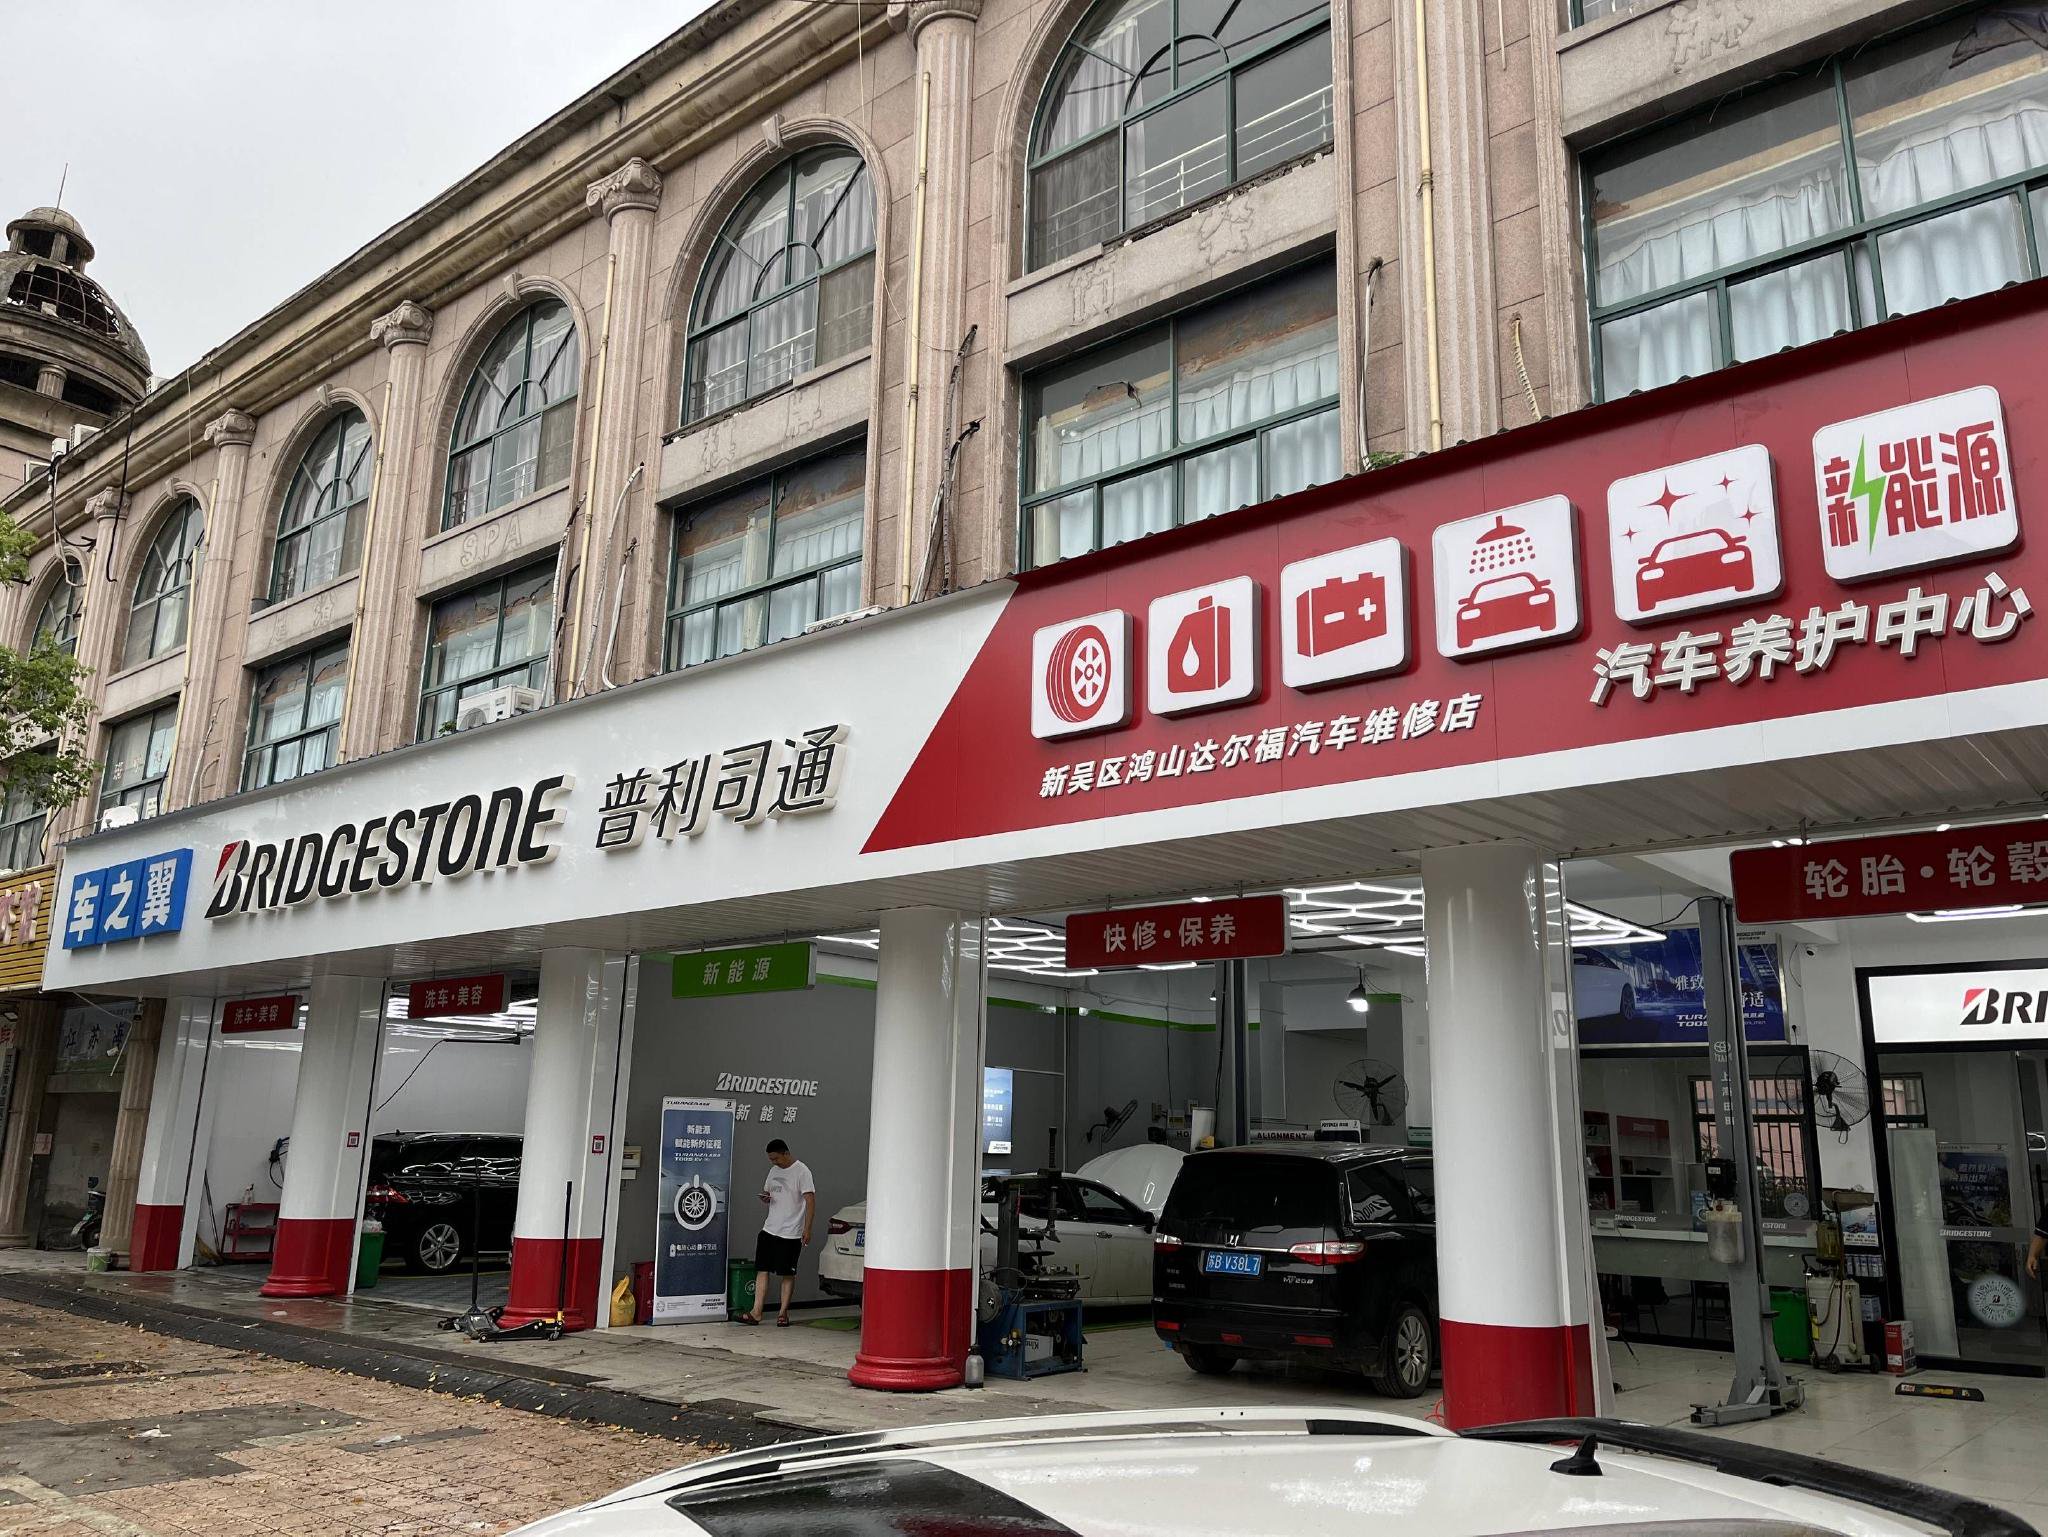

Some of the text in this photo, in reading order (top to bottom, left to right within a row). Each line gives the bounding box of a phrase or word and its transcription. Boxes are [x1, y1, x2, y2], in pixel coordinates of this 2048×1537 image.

[1823, 419, 2006, 553] 新能源
[460, 519, 523, 568] SPA
[1591, 571, 2033, 705] 汽车养护中心
[1039, 692, 1481, 799] 新吴区鸿山达尔福汽车维修店
[596, 724, 846, 851] 普利司通
[205, 775, 572, 919] BRIDGESTONE
[69, 858, 177, 941] 车之翼
[1104, 914, 1236, 953] 快修·保养
[703, 957, 772, 986] 新能源
[234, 1004, 279, 1025] 洗车·美容
[424, 985, 482, 1009] 洗车·美容
[716, 1072, 819, 1096] BRIDGESTONE
[736, 1104, 798, 1123] 新能源
[1257, 1131, 1308, 1141] ALIGNMENT
[1940, 1229, 1992, 1238] BRIDGESTONE
